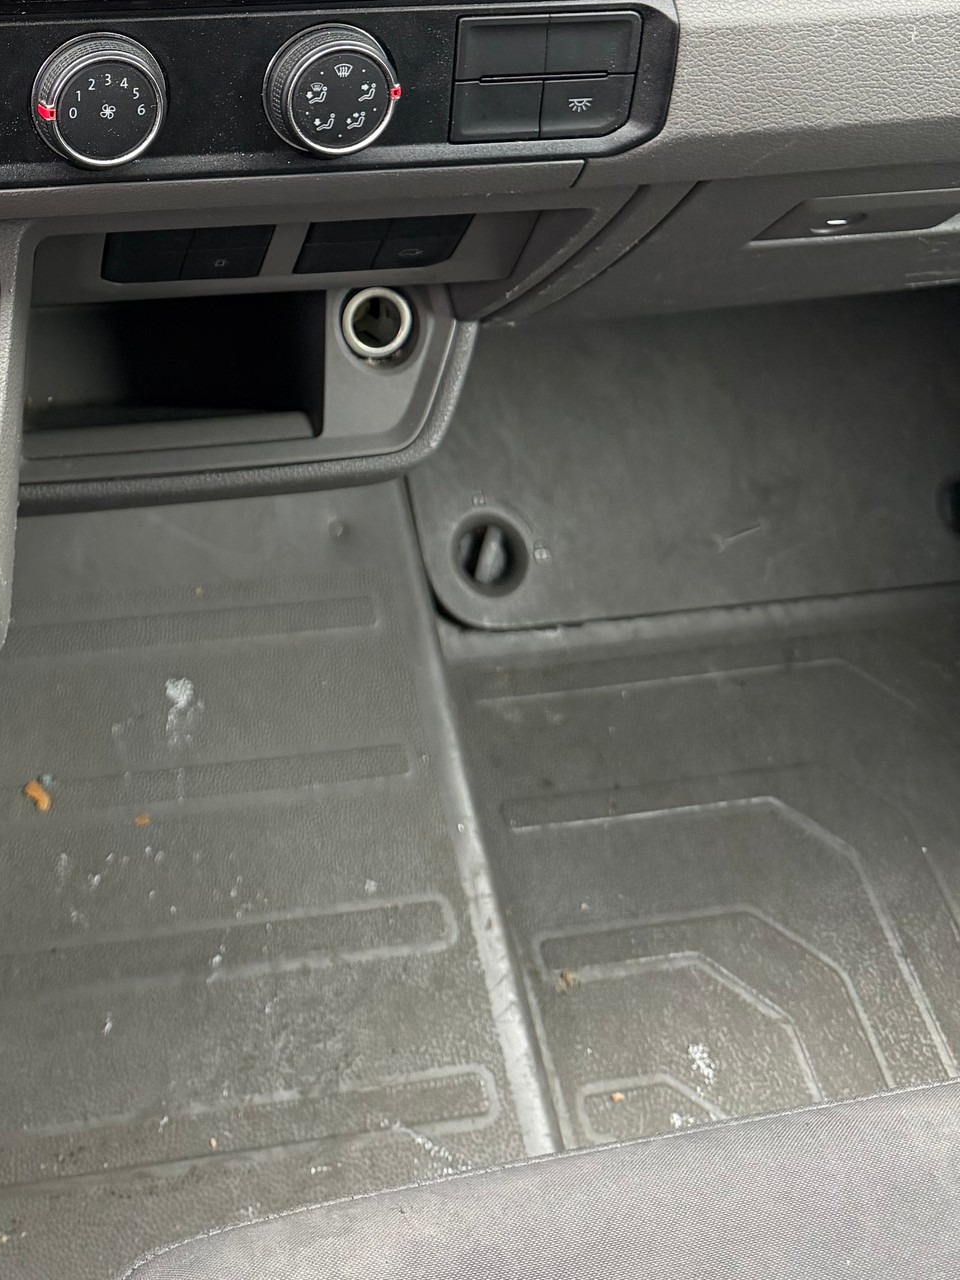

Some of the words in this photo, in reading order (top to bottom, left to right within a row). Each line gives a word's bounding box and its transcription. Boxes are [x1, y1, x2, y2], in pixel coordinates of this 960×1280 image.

[68, 107, 78, 119] 0
[75, 90, 81, 102] 1
[88, 78, 96, 91] 2
[104, 73, 112, 86] 3
[120, 77, 129, 89] 4
[132, 87, 140, 100] 5
[137, 103, 146, 116] 6
